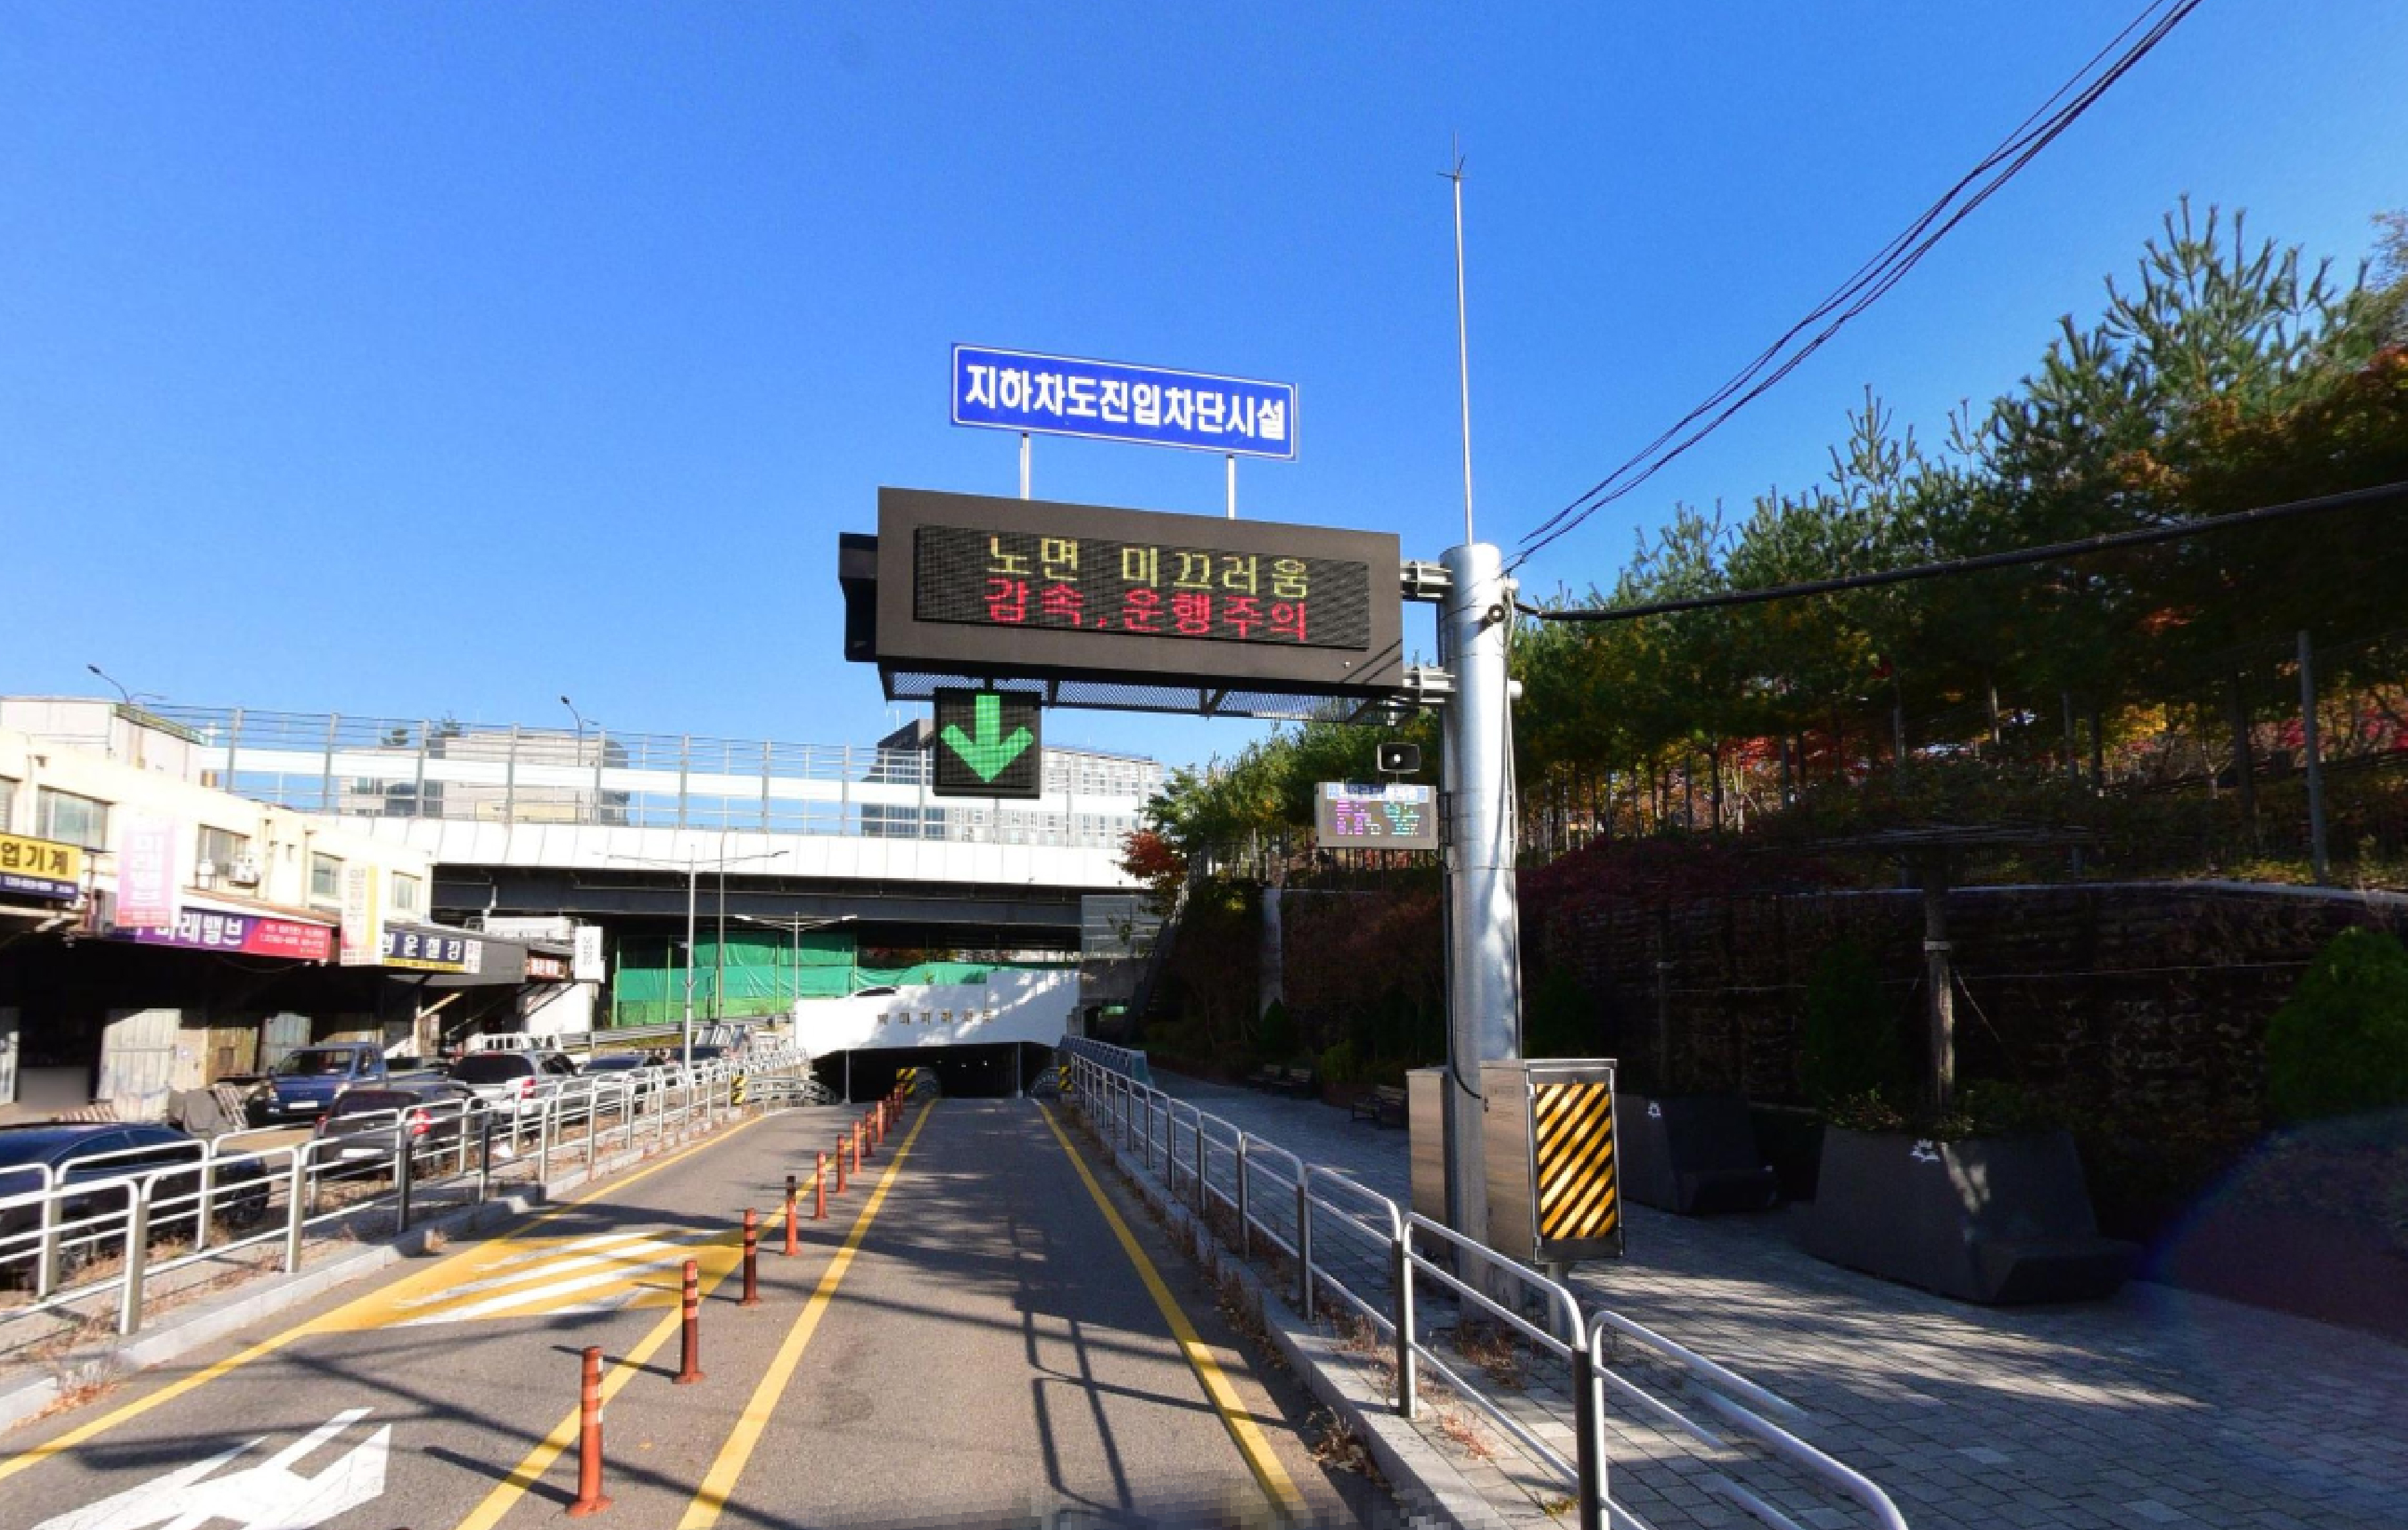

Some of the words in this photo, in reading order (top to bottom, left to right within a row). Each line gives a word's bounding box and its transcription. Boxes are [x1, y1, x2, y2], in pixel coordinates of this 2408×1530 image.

[966, 364, 1285, 440] 지하차도진입차단시설
[987, 535, 1078, 581] 노면
[1121, 545, 1307, 598] 미끄러움
